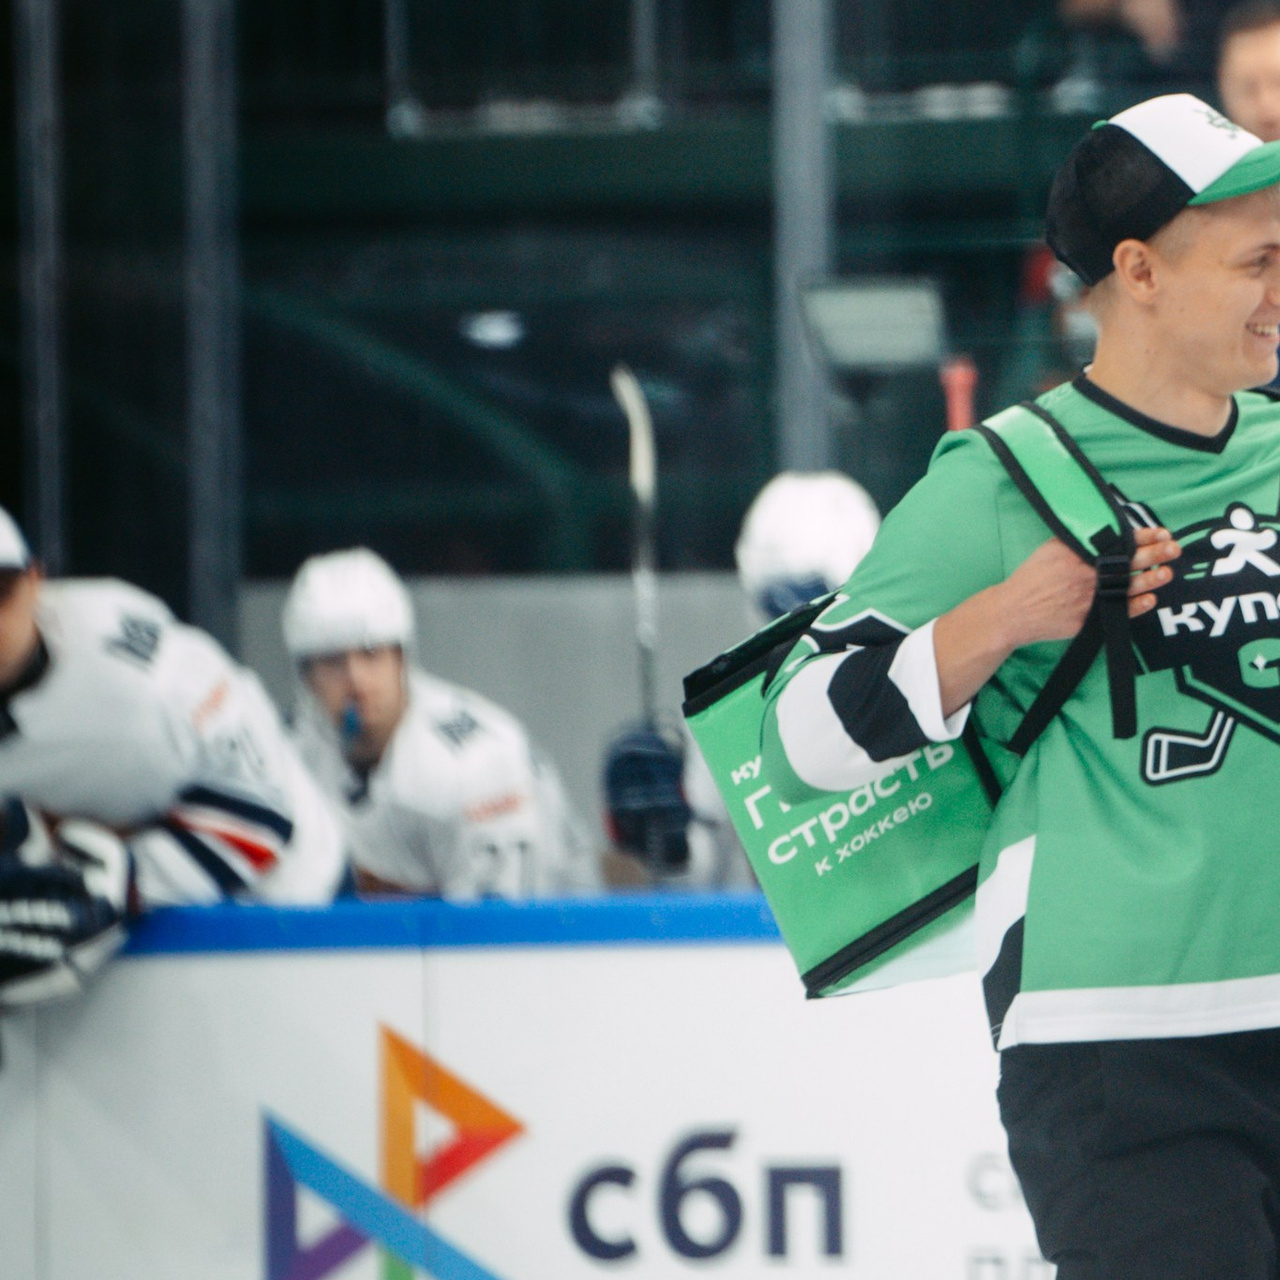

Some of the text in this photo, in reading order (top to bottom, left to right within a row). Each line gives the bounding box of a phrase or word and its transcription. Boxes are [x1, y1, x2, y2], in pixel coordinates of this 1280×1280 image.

[730, 754, 763, 786] ку
[767, 742, 955, 865] страсть
[814, 855, 833, 877] к
[836, 791, 933, 864] хоккею
[567, 1129, 844, 1262] сбп
